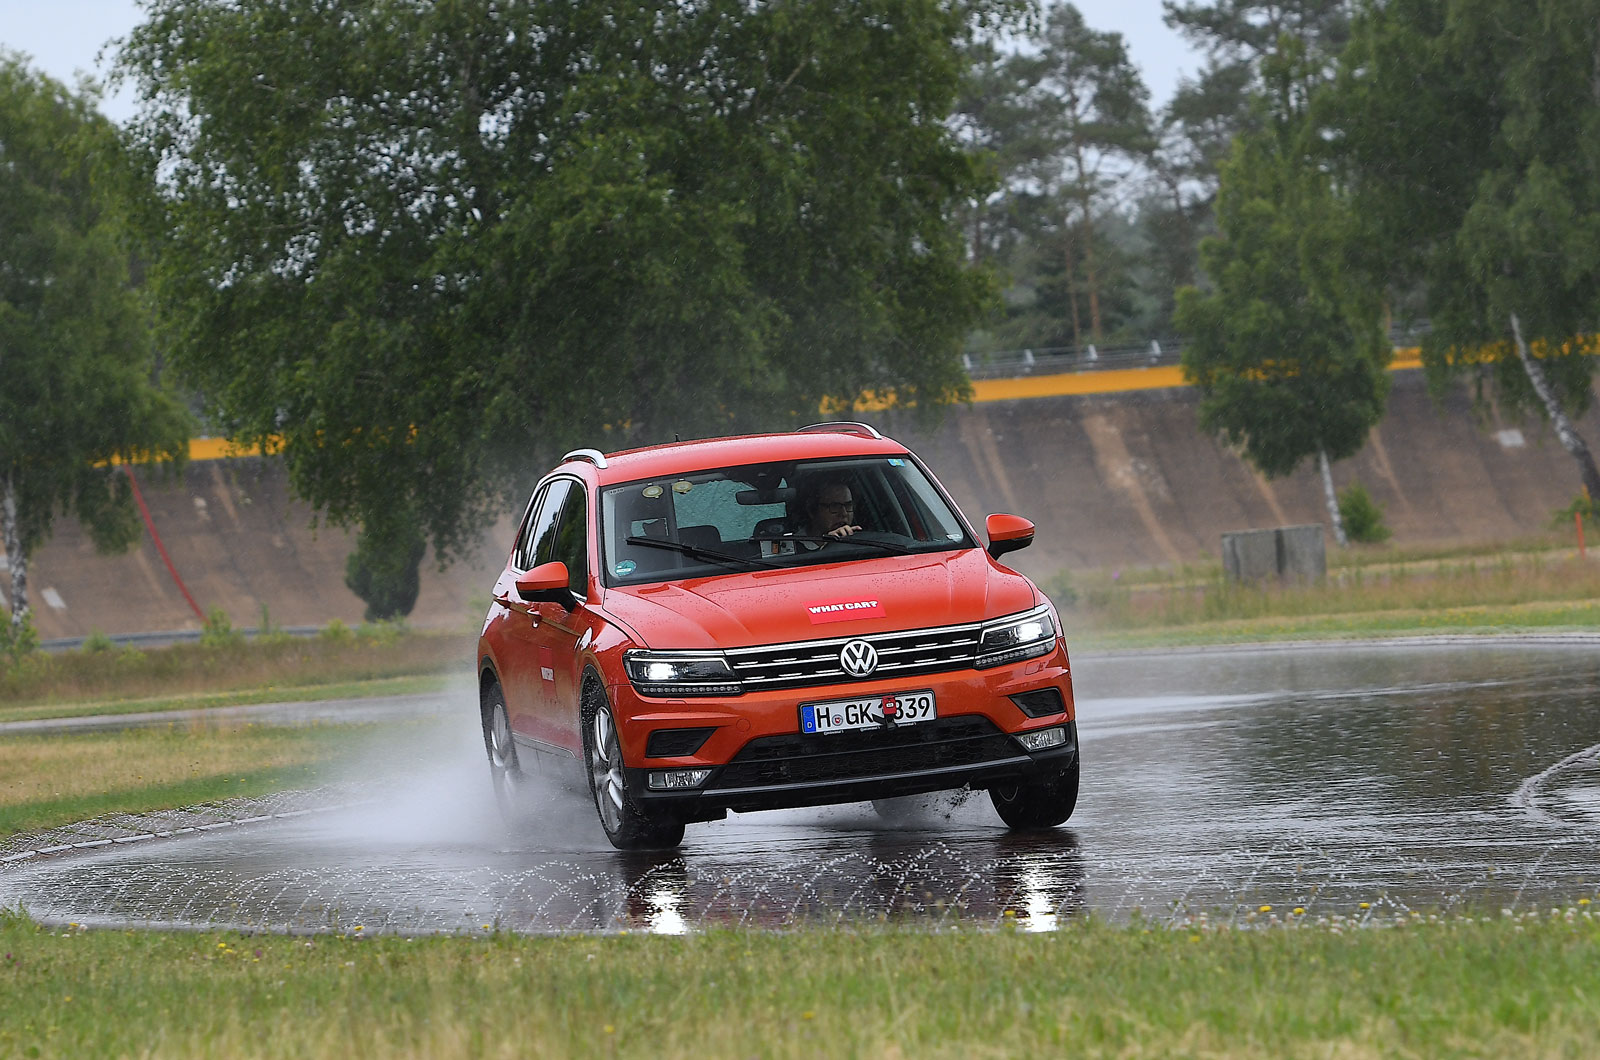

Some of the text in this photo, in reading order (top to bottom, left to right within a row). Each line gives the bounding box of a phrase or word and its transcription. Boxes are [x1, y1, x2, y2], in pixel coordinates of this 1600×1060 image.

[841, 640, 878, 678] VW
[816, 696, 930, 728] H GK 839
